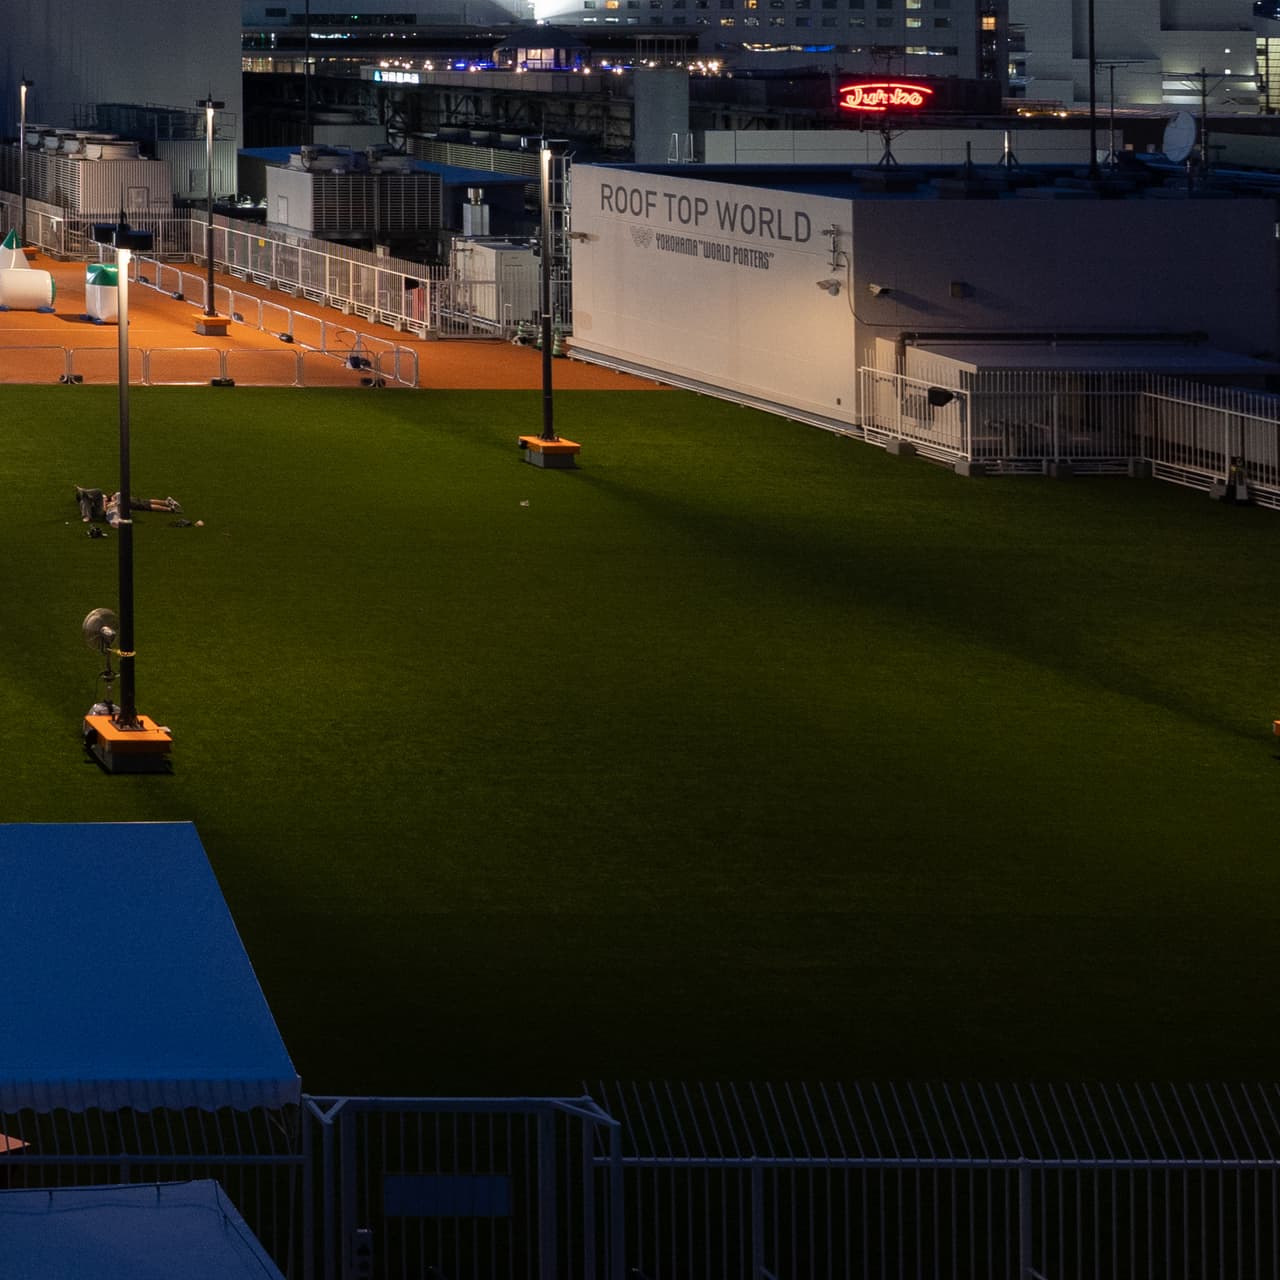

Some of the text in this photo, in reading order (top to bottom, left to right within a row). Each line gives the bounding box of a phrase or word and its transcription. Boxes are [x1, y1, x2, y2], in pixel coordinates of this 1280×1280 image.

[601, 183, 811, 243] ROOF TOP WORLD
[655, 232, 698, 257] YOKOHAMA
